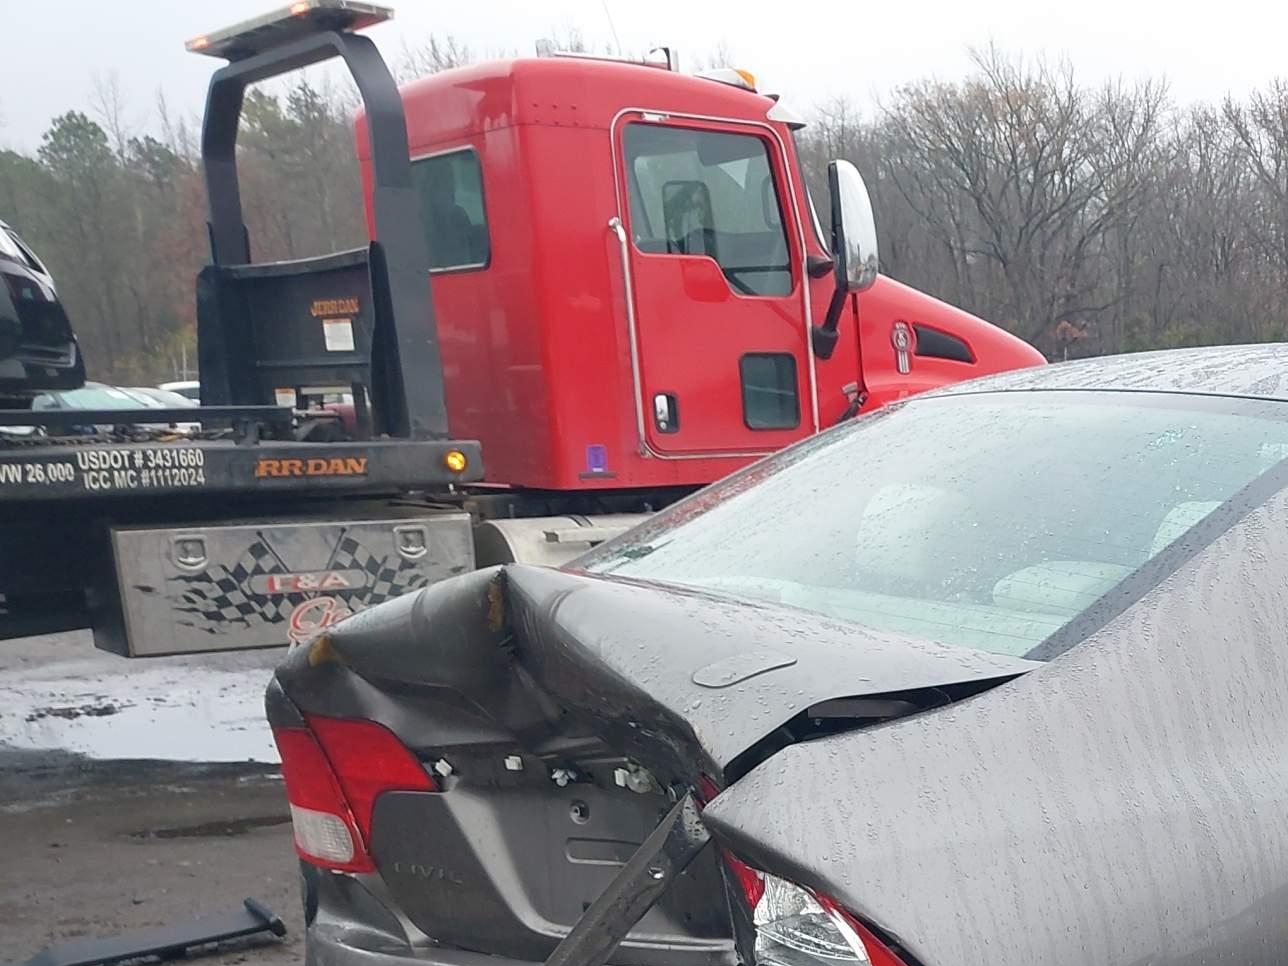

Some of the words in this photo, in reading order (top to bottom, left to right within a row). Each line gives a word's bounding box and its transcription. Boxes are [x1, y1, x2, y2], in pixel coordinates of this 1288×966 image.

[77, 451, 131, 470] USDOT
[134, 450, 143, 468] #
[147, 449, 205, 468] 3431660
[306, 457, 368, 476] DAN
[26, 463, 75, 485] 26,000
[83, 472, 110, 489] ICC
[114, 471, 137, 488] MC
[141, 469, 205, 487] #1112024
